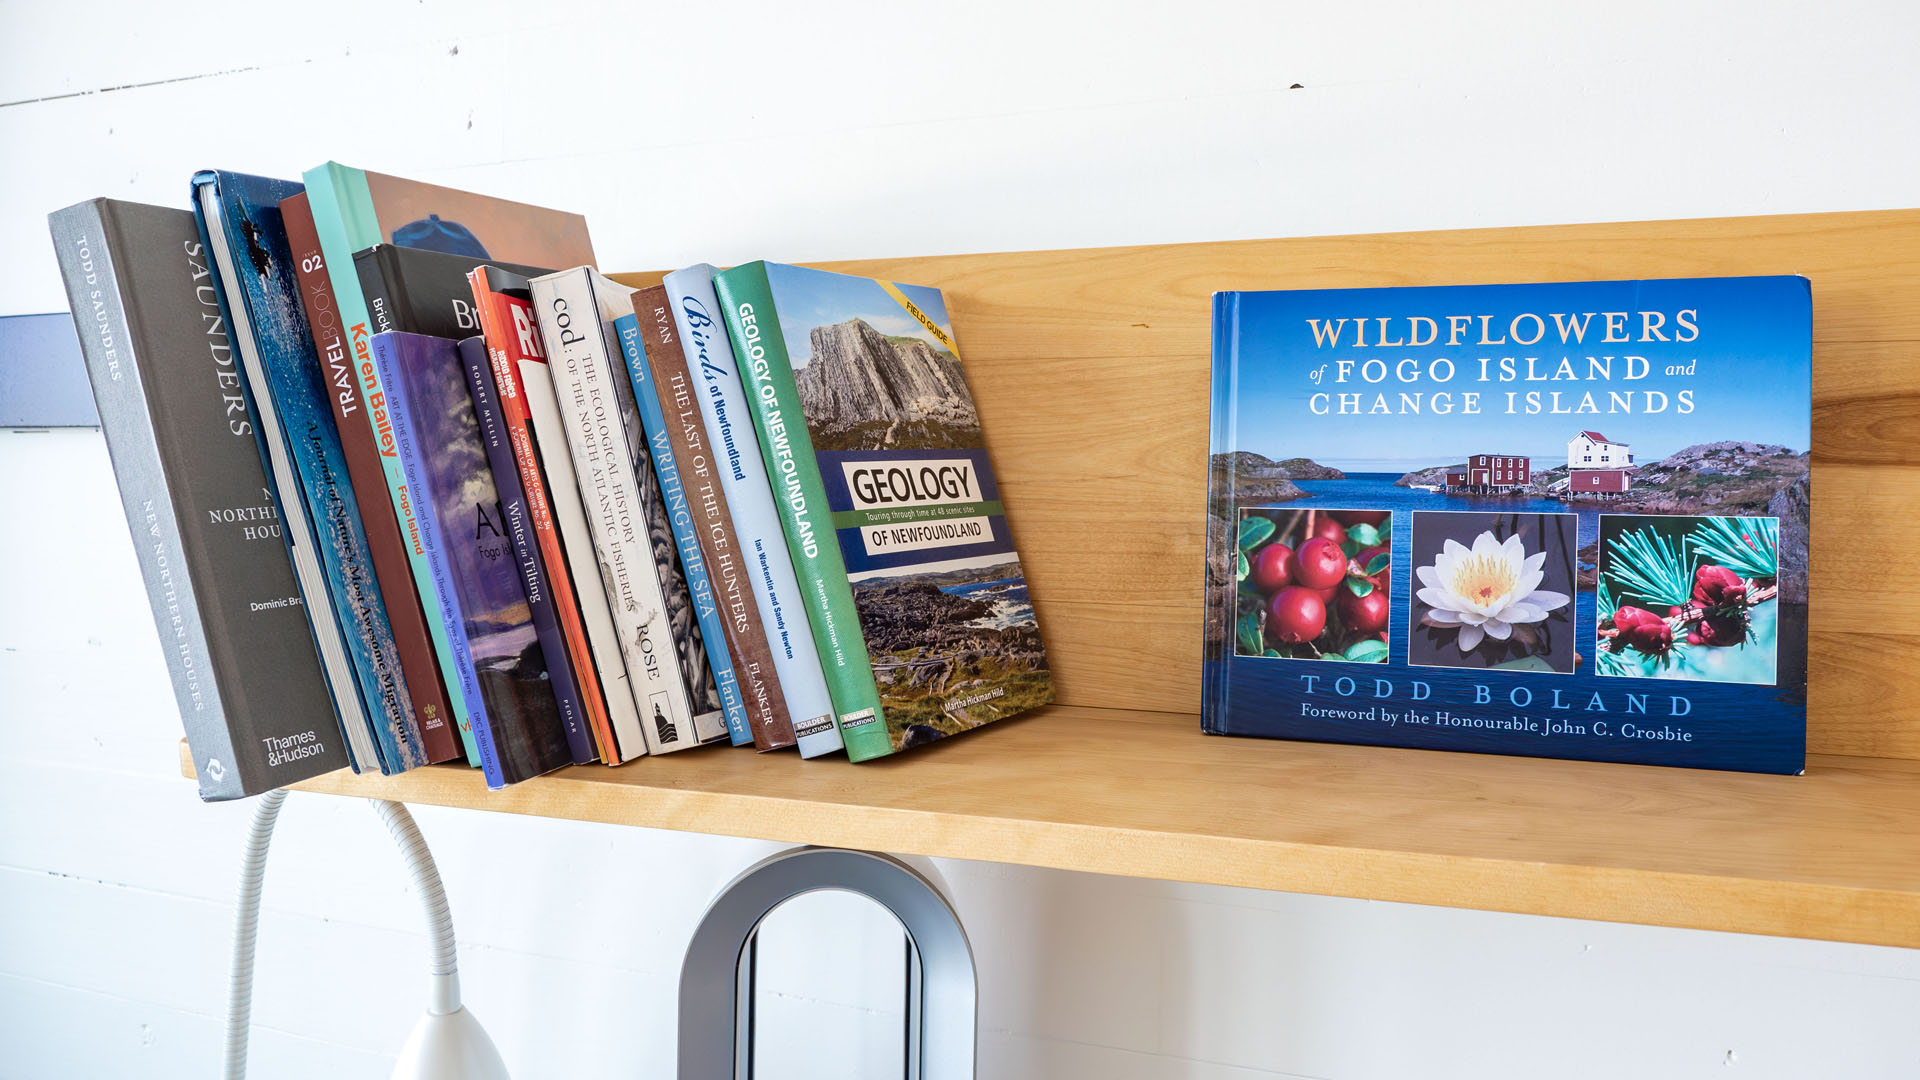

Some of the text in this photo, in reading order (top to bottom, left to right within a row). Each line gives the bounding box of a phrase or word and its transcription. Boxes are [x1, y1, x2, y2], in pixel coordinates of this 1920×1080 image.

[302, 254, 323, 273] 02
[76, 236, 122, 382] TODD SAUNDERS
[906, 301, 948, 344] FIELD GUIDE
[184, 240, 252, 437] SAUNDERS
[654, 306, 673, 344] RYAN
[1306, 309, 1700, 349] WILDFLOWERS
[622, 327, 646, 384] Brown
[1309, 355, 1697, 385] of FOGO ISLAND and
[391, 396, 400, 410] ART
[682, 296, 746, 481] Birds of Newfoundland
[1309, 389, 1695, 416] CHANGE ISLANDS
[394, 412, 403, 421] AT
[471, 365, 498, 447] ROBERT MELLIN
[350, 322, 424, 555] Karen Bailey Fogo Island
[398, 422, 407, 436] THE
[739, 302, 818, 559] GEOLOGY OF NEWFOUNDLAND
[401, 439, 413, 460] EDGE
[519, 432, 532, 458] JOURNAL
[582, 353, 636, 545] THE ECOLOGICAL HISTORY
[407, 463, 417, 482] Fogo
[526, 458, 535, 468] OF
[529, 468, 538, 482] ARTS
[413, 484, 424, 505] Island
[535, 488, 546, 510] CULTURE
[566, 358, 635, 613] OF THE NORTH ATLANTIC FISHERIES
[852, 466, 971, 504] GEOLOGY
[418, 506, 427, 521] and
[670, 371, 750, 634] THE LAST OF THE ICE HUNTERS
[865, 505, 975, 522] Touring through time at 48 scenic sites
[423, 520, 434, 550] Change
[652, 429, 715, 620] WRITING THE SEA
[872, 522, 981, 547] OF NEWFOUNDLAND
[431, 552, 441, 577] Islands
[478, 546, 500, 561] Fogo
[508, 500, 541, 604] Winter in Tilting
[307, 421, 407, 744] A Journal of Nature's Most Awesome Migration
[437, 577, 450, 607] Through
[143, 499, 204, 712] NEW NORTHERN HOUSES
[250, 599, 288, 612] Dominic
[445, 607, 453, 619] the
[754, 539, 794, 660] Ian Warkentin and Sandy Newton
[815, 579, 845, 667] Martha Hickman Hild
[636, 624, 661, 681] ROSE
[717, 667, 744, 734] Flanker
[749, 662, 774, 726] FLANKER
[944, 687, 1005, 712] Martha Hickman Hild
[1300, 675, 1692, 717] TODD BOLAND
[563, 699, 577, 734] PEDLAR
[797, 716, 826, 730] BOULDER
[797, 723, 833, 738] PUBLICATIONS
[843, 709, 870, 722] BOULDER
[843, 717, 875, 730] PUBLICATIONS
[1300, 702, 1693, 743] Foreword by the Honourable John C. Crosbie
[262, 730, 316, 753] Thames
[268, 742, 325, 767] &Hudson
[473, 711, 495, 775] DRC PUBLISHING
